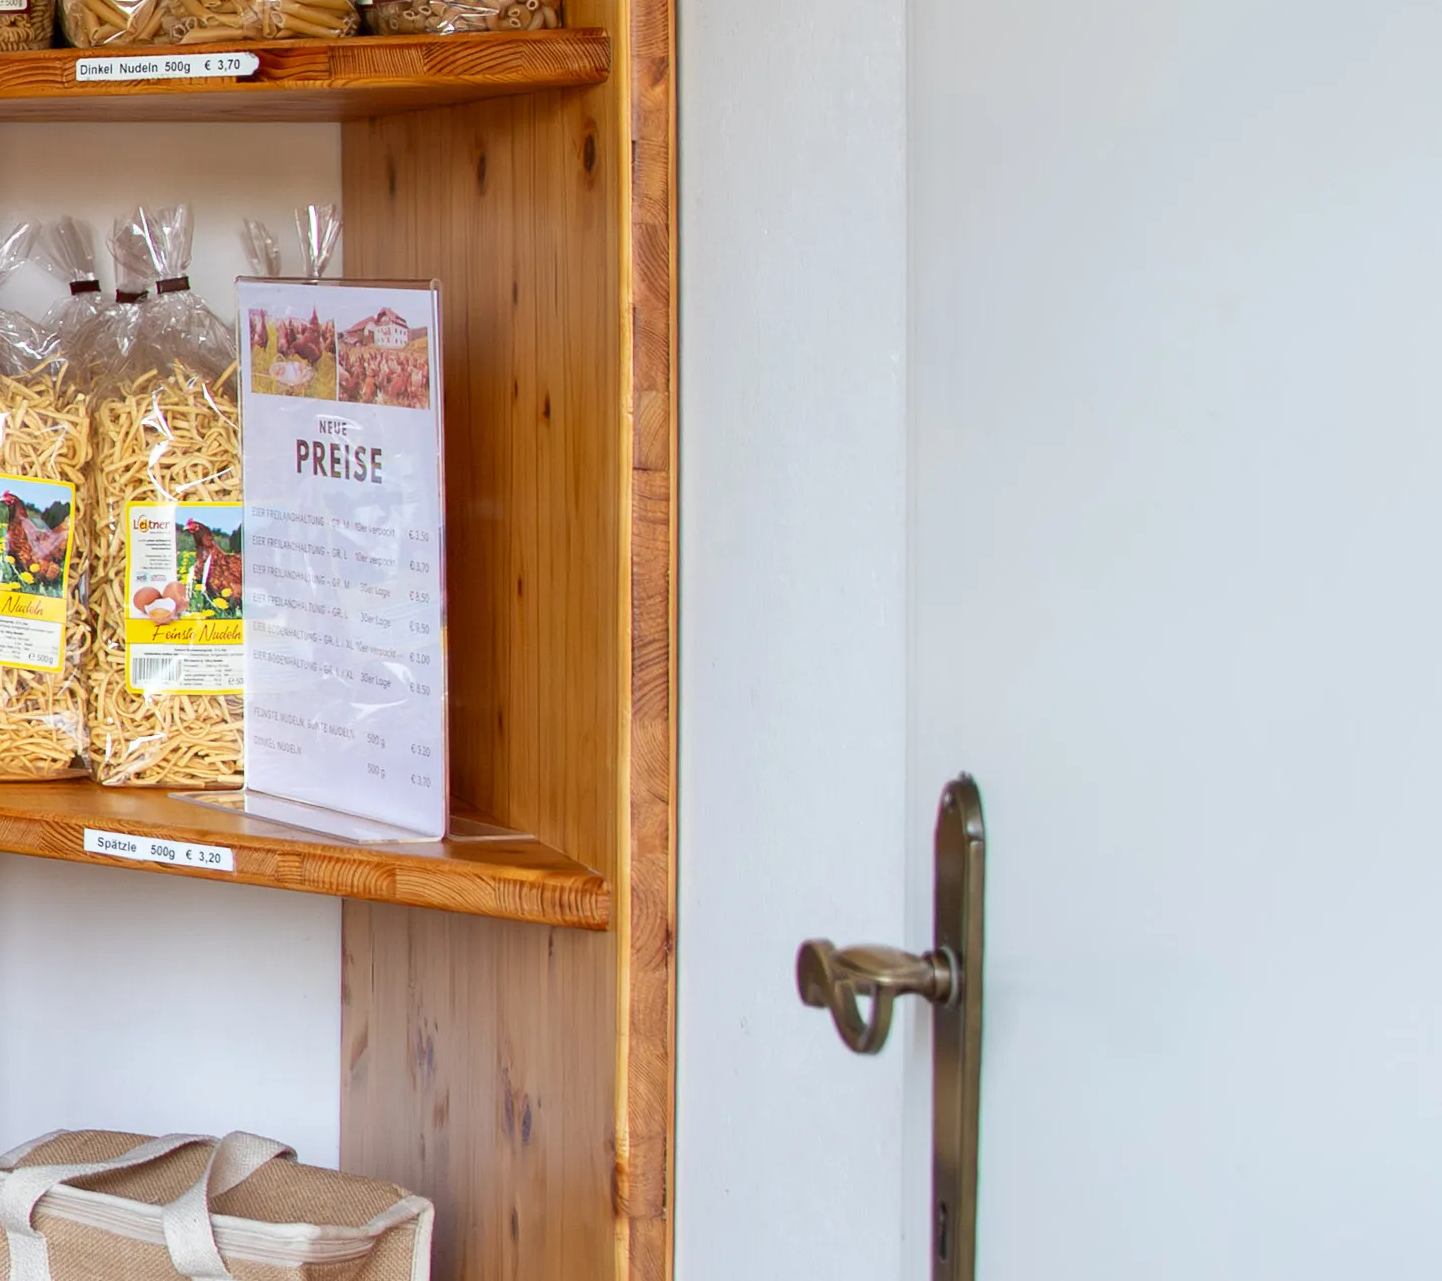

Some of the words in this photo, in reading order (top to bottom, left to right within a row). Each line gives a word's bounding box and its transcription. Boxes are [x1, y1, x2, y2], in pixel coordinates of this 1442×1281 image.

[79, 63, 114, 76] Dinkel
[119, 62, 159, 75] Nudeln
[164, 60, 191, 75] 500g
[217, 58, 241, 72] 3,70
[318, 419, 348, 436] NEUE
[295, 438, 383, 485] PREISE
[133, 514, 171, 534] Leitner
[151, 623, 195, 642] Feinste
[197, 623, 242, 642] Nudeln
[97, 836, 137, 853] Spätzle
[150, 844, 176, 861] 500g
[198, 850, 222, 864] 3,20
